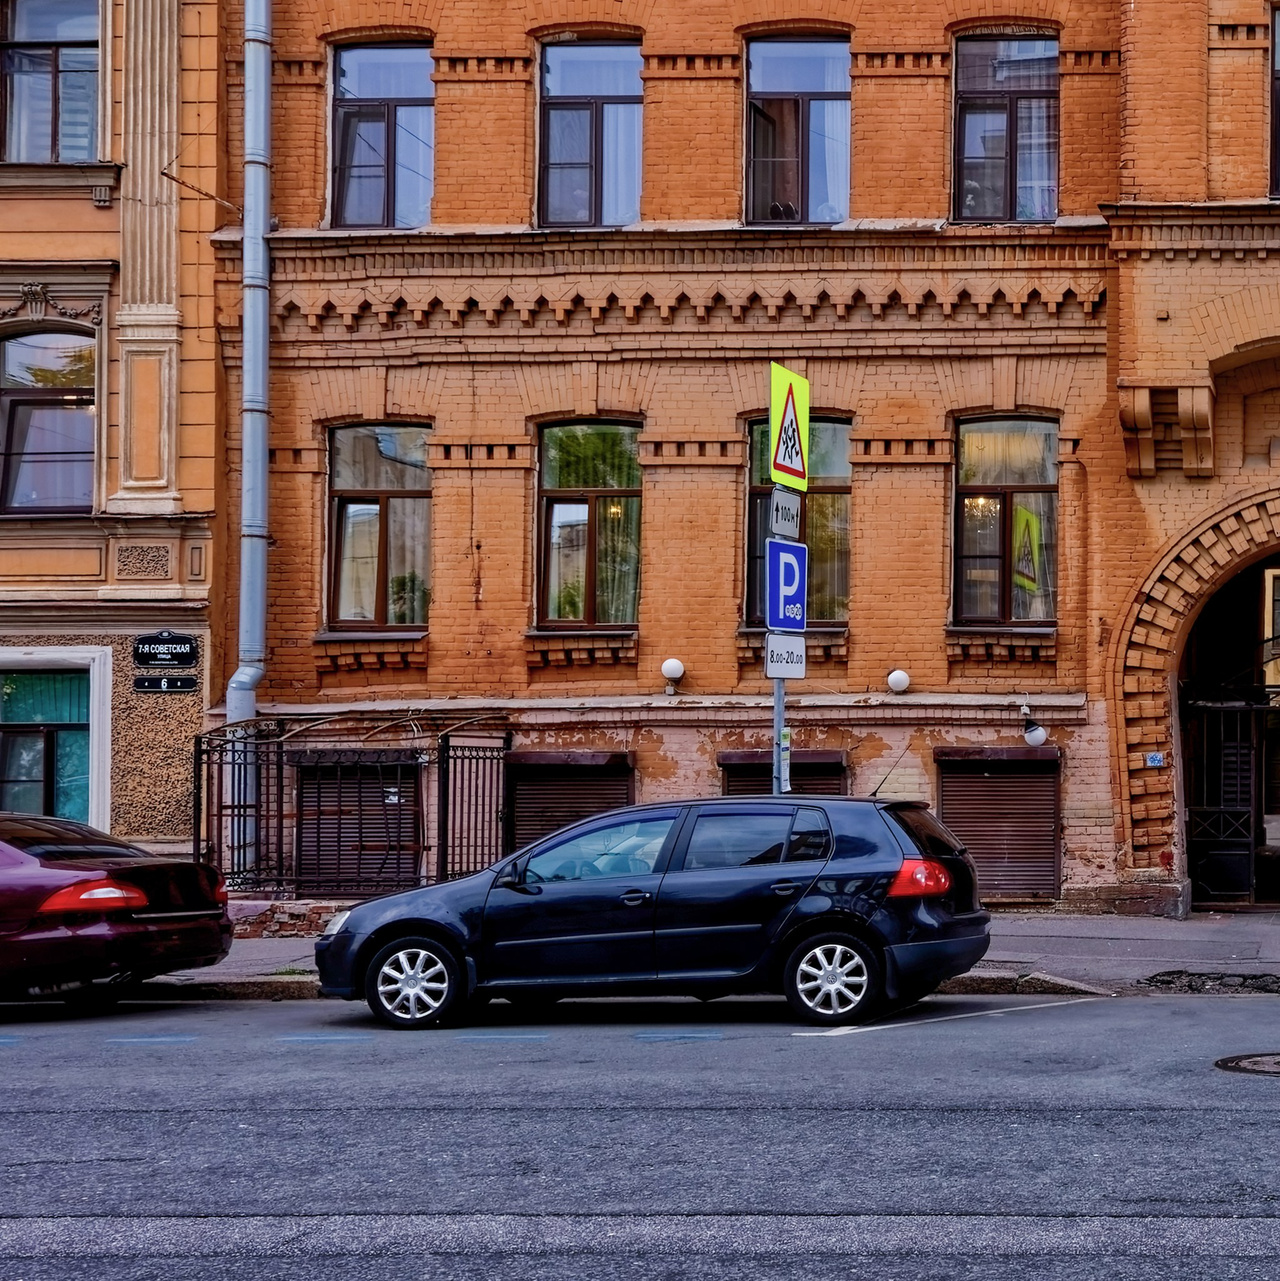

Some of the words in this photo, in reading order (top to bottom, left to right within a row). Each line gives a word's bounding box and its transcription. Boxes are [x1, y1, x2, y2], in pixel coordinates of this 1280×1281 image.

[779, 552, 800, 619] P
[150, 644, 190, 653] СОВЕТСКАЯ
[770, 650, 803, 664] 8.00-20.00
[161, 679, 167, 689] 6
